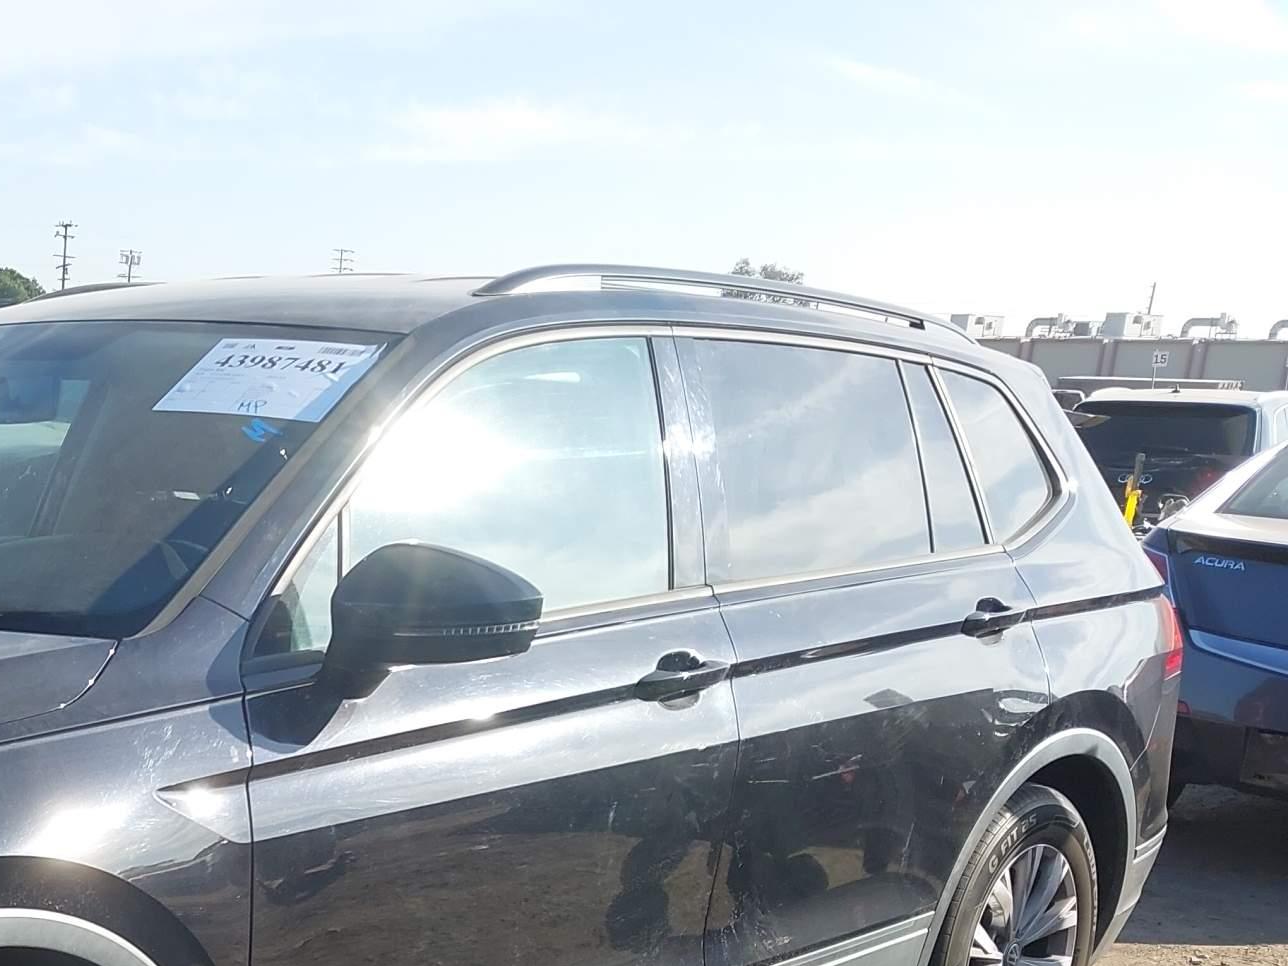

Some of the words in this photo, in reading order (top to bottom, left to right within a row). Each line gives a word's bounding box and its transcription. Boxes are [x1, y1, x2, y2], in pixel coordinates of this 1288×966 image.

[214, 353, 346, 375] 43987481
[1154, 354, 1168, 365] 15
[1193, 556, 1246, 571] ACURA
